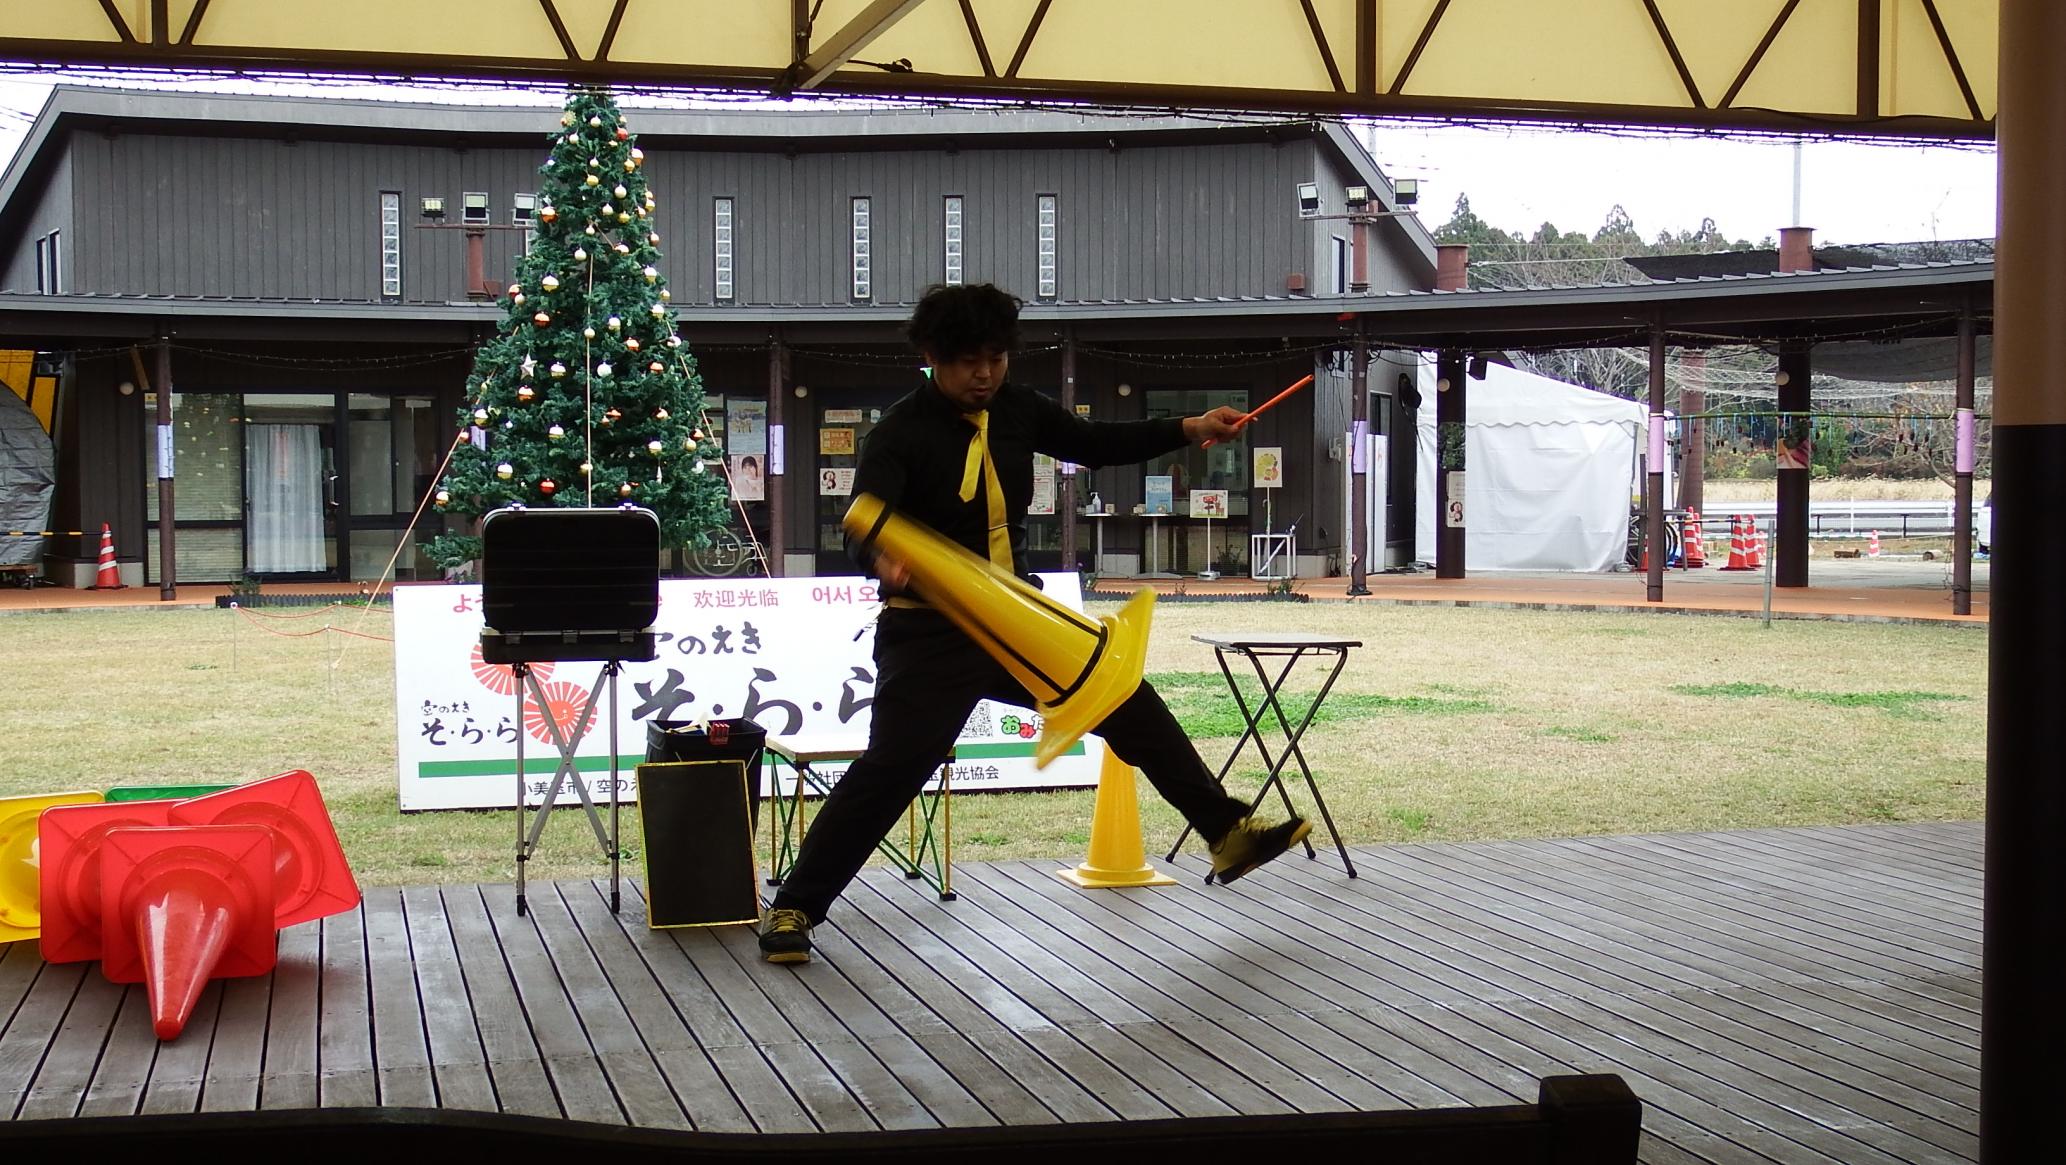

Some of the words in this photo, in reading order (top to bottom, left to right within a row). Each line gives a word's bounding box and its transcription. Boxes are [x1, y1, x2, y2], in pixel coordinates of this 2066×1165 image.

[453, 593, 483, 613] よ
[693, 588, 779, 609] 欢迎光临
[812, 586, 852, 605] 어서
[654, 621, 762, 660] のえき
[421, 699, 470, 716] 空のえき
